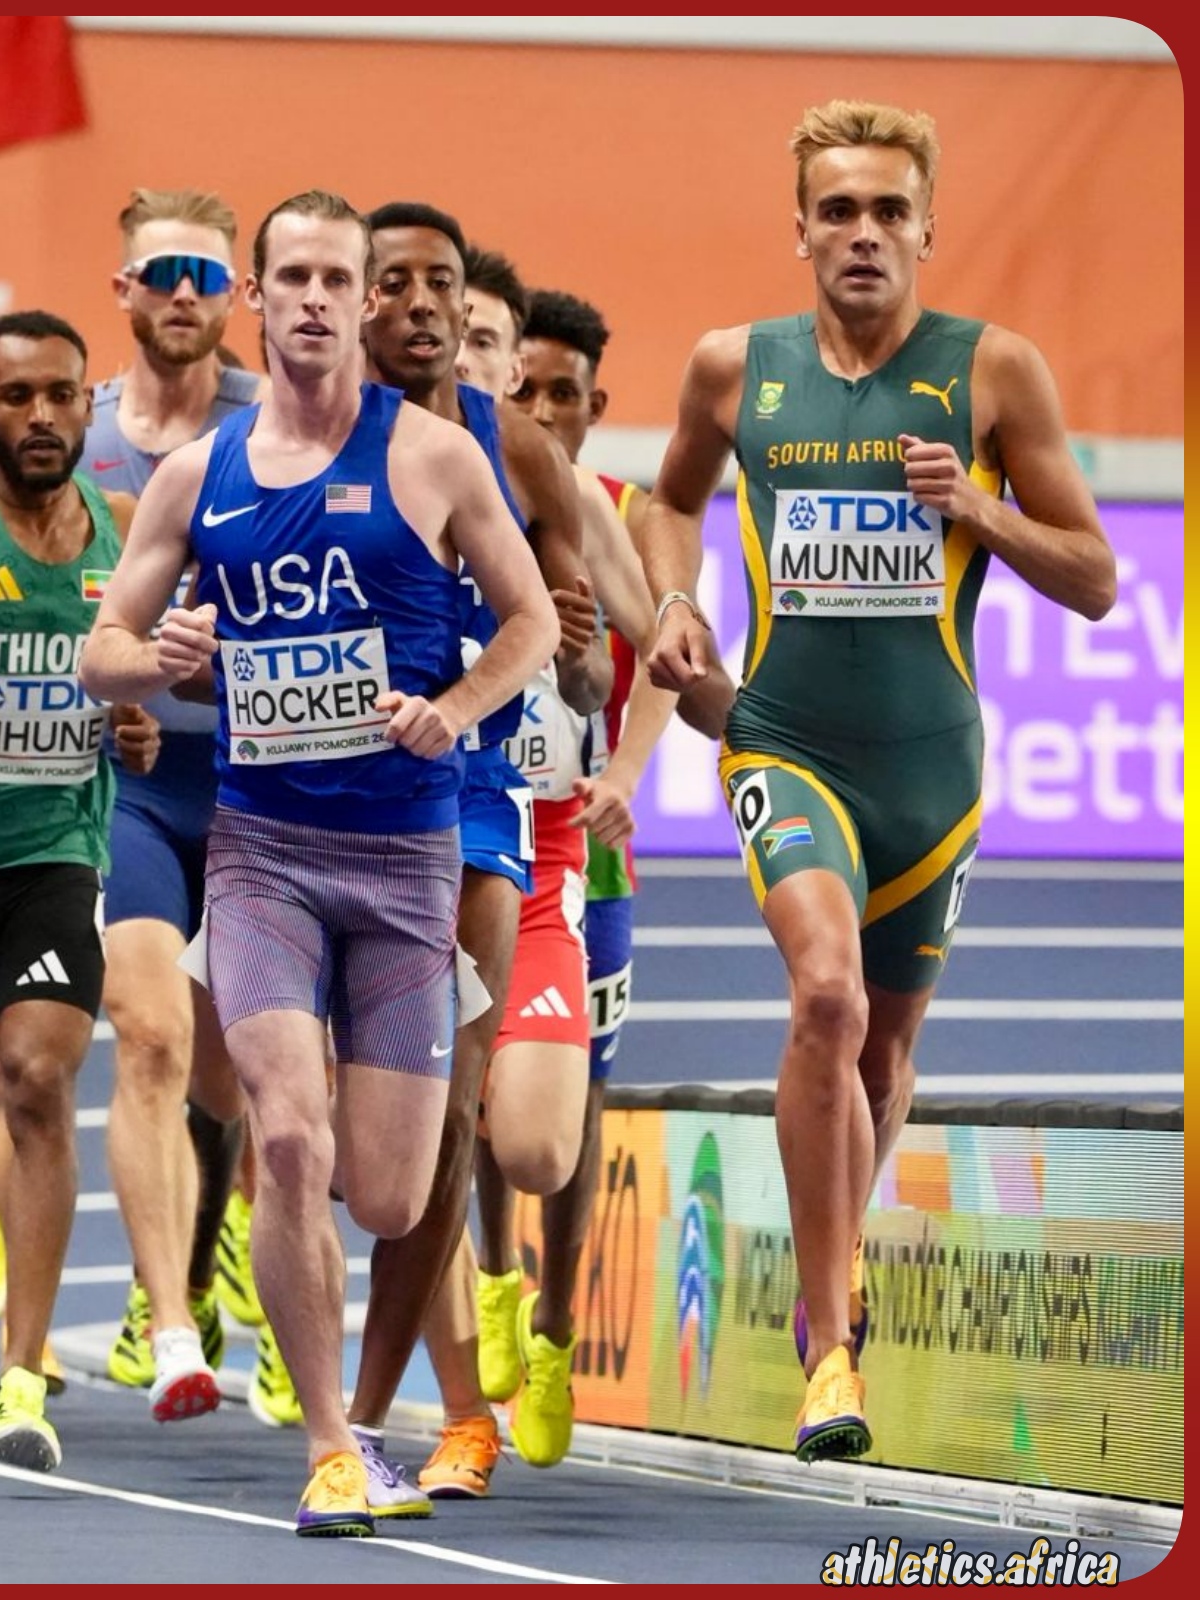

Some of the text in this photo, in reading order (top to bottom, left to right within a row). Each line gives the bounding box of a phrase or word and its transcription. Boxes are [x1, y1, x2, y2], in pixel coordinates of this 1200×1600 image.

[768, 442, 838, 469] SOUTH
[818, 496, 932, 532] TDK
[781, 543, 935, 582] MUNNIK
[217, 546, 369, 625] USA
[815, 595, 938, 608] KUJAWY POMORZE 26
[253, 636, 371, 681] TDK
[234, 678, 380, 726] HOCKER
[266, 742, 312, 756] KUJAWY
[314, 735, 370, 751] POMORZE
[591, 977, 627, 1027] 15
